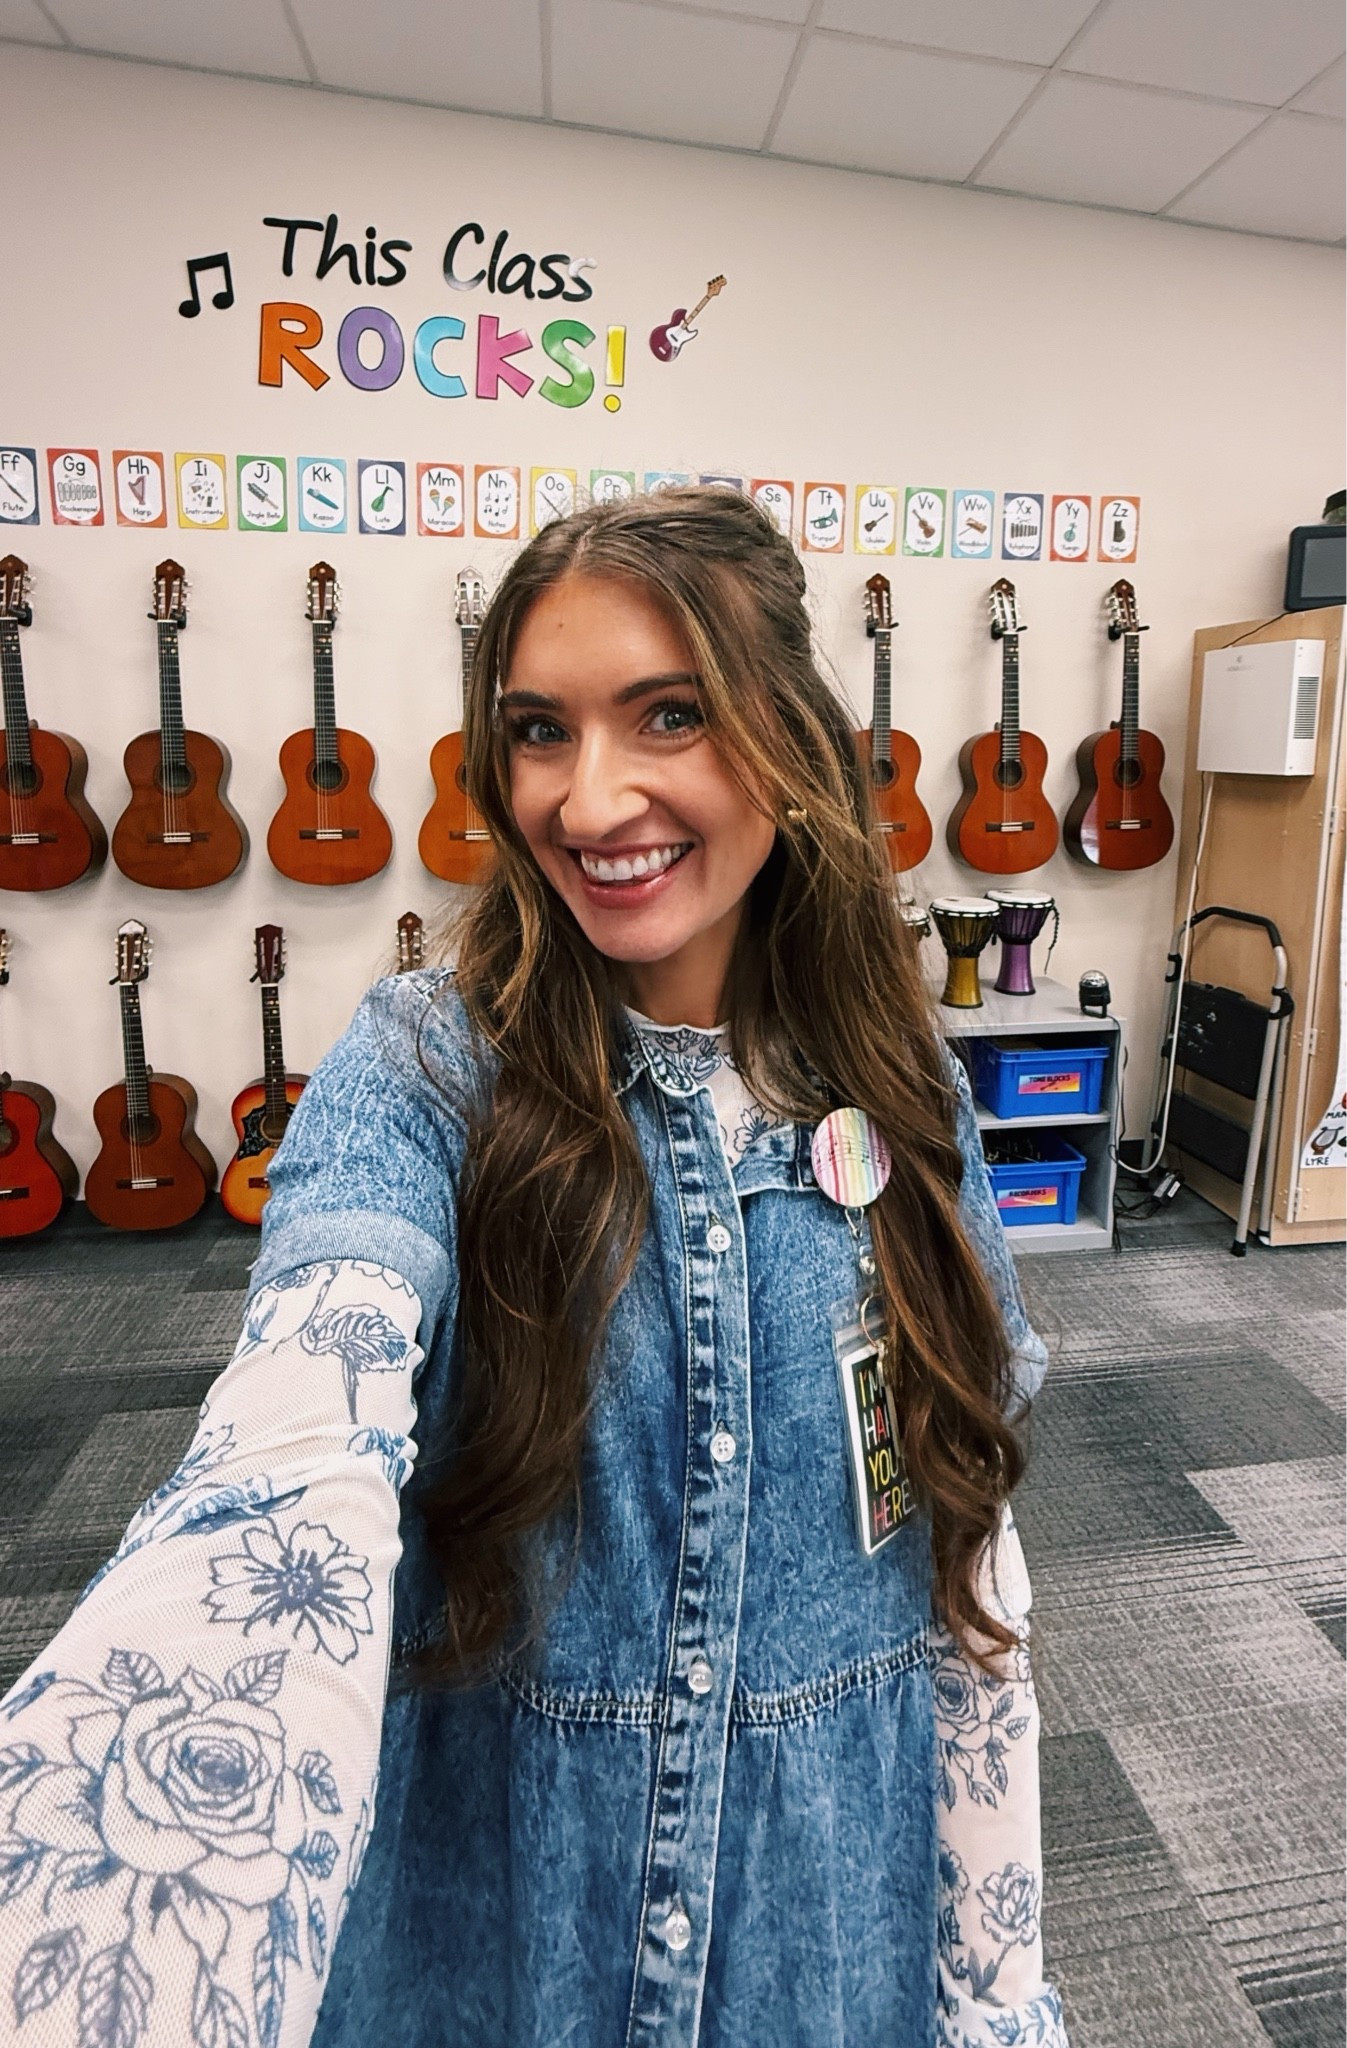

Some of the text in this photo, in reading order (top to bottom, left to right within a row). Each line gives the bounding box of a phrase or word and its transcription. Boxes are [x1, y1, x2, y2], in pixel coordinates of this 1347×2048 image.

[262, 213, 598, 303] This Class
[257, 301, 627, 413] ROCKS!
[1, 453, 21, 471] Ff
[62, 455, 87, 476] Gg
[127, 458, 150, 475] Hh
[193, 460, 208, 476] Ii
[254, 462, 270, 483] Jj
[312, 466, 332, 483] Kk
[375, 468, 389, 484] Ll
[427, 470, 455, 487] Mm
[488, 473, 507, 488] Nn
[545, 475, 565, 491] Oo
[765, 486, 781, 502] Ss
[818, 489, 832, 505] Tt
[868, 493, 886, 508] Uu
[917, 494, 934, 510] Vv
[2, 502, 24, 512] Flute
[133, 507, 152, 517] Harp
[963, 498, 987, 511] Ww
[1016, 500, 1032, 515] Xx
[1065, 502, 1080, 519] Yy
[1112, 503, 1129, 518] Zz
[313, 513, 334, 521] Kazoo
[375, 515, 391, 523] Lute
[427, 518, 456, 526] Maracas
[488, 520, 506, 528] Notes
[1305, 1156, 1330, 1166] LYRE
